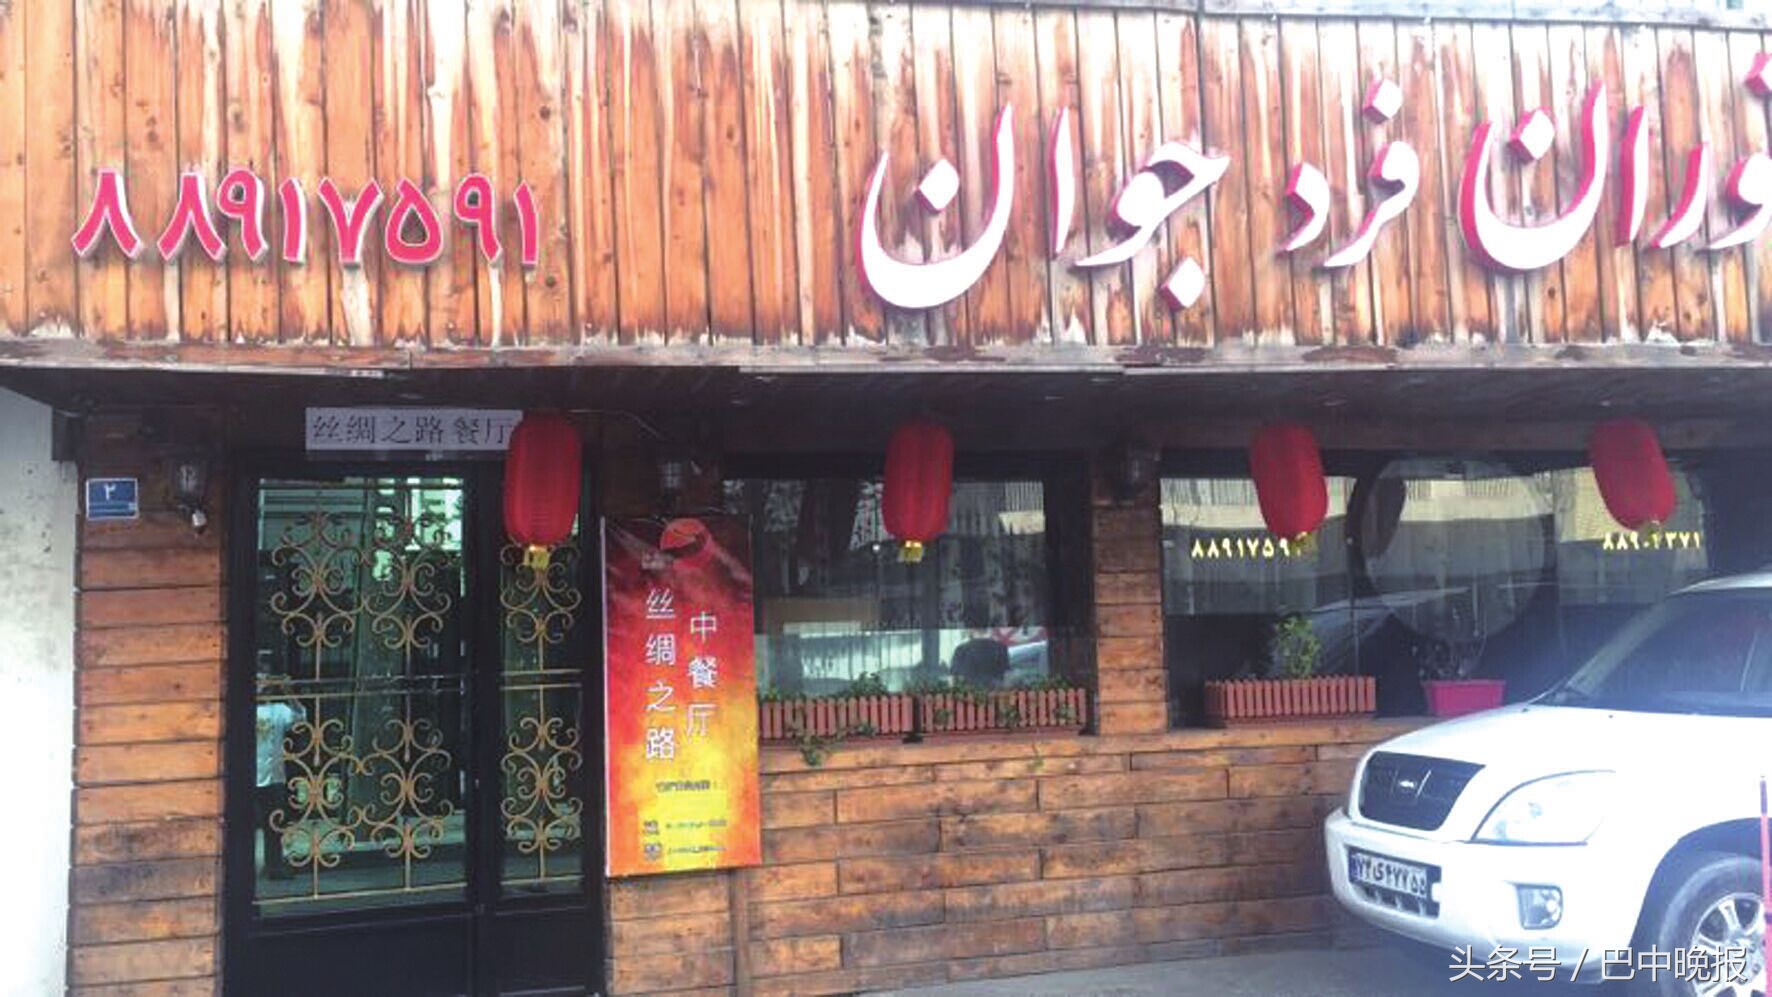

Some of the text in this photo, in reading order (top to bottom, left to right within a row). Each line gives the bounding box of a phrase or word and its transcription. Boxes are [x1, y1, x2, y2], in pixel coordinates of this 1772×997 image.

[72, 169, 539, 267] ۸۸۹۱۷۵۹۱
[857, 101, 1231, 310] جوان
[645, 587, 677, 761] 丝绸之路
[686, 611, 718, 738] 中餐厅
